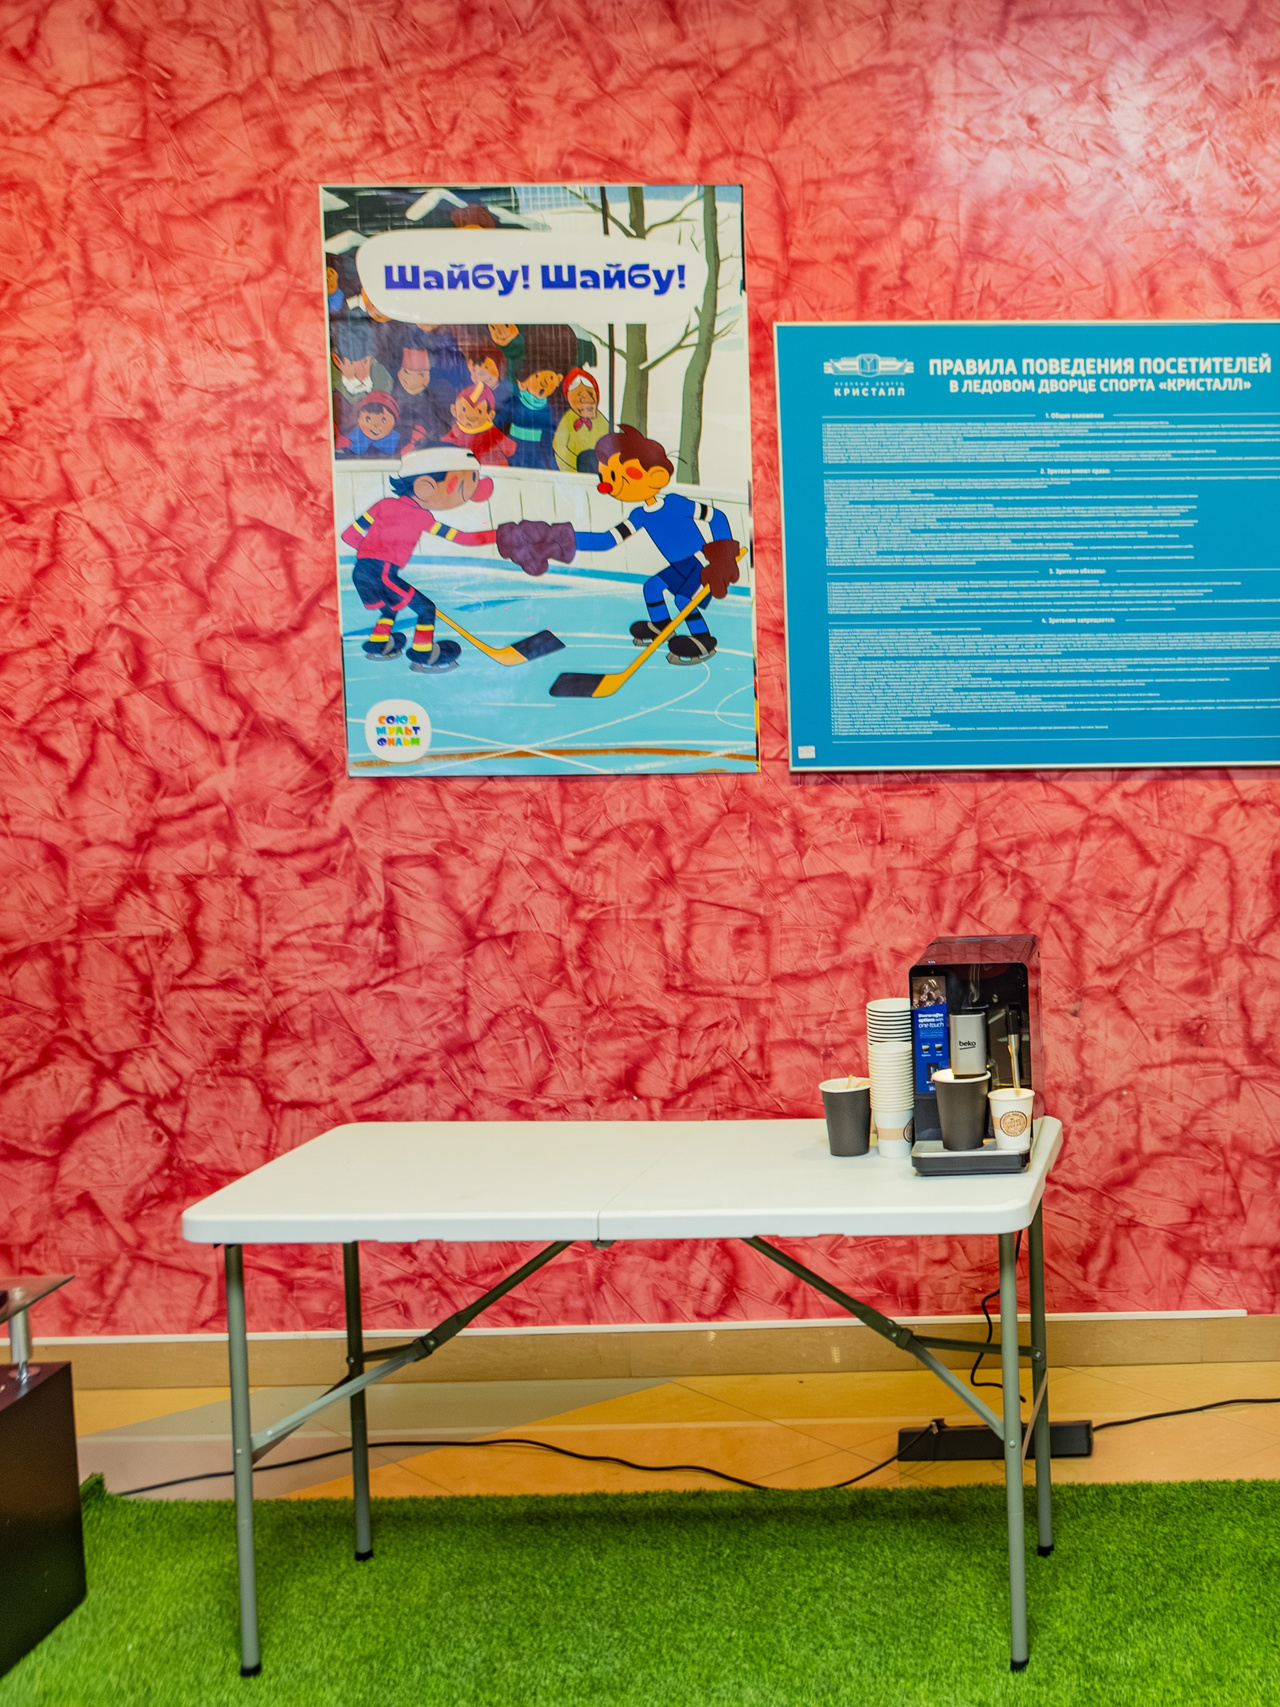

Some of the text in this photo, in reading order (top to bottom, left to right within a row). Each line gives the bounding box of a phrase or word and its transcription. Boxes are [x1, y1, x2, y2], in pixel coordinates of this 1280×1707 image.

[384, 263, 686, 297] Шайбу! Шайбу!
[929, 353, 1271, 377] ПРАВИЛА ПОВЕДЕНИЯ ПОСЕТИТЕЛЕЙ
[950, 377, 1251, 394] В ЛЕДОВОМ ДВОРЦЕ СПОРТА «КРИСТАЛЛ»
[378, 715, 418, 725] СОЮЗ
[376, 726, 421, 736] МУЛЬТ
[377, 737, 420, 747] ФИЛЬМ
[959, 1040, 976, 1048] beko
